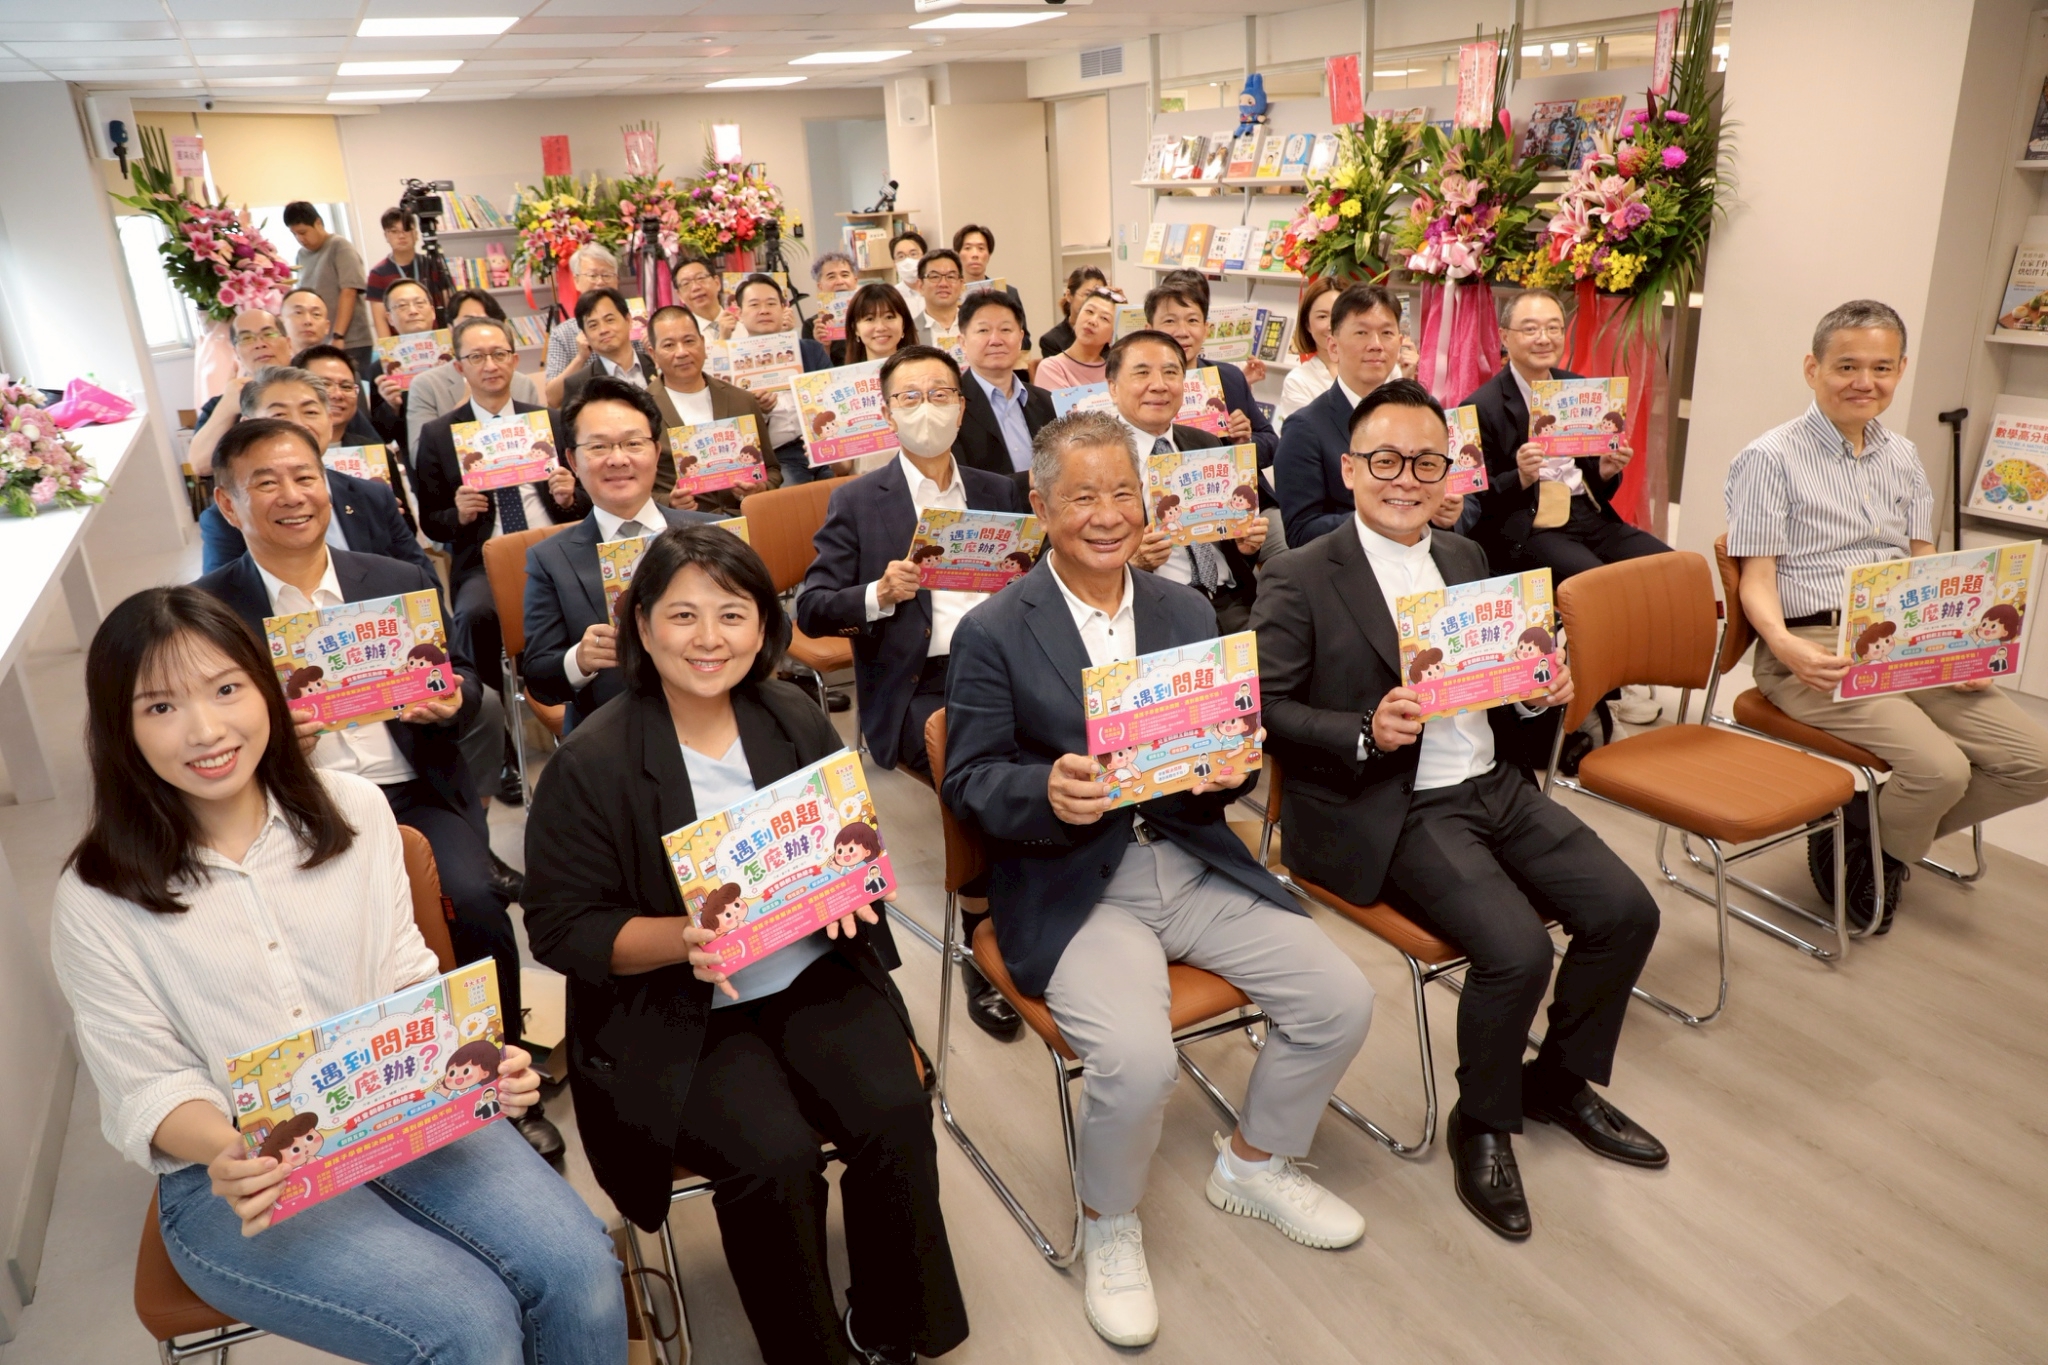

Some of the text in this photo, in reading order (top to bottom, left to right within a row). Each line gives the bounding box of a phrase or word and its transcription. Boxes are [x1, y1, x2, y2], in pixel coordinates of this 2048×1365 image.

[1557, 392, 1603, 409] 遇到問題
[1560, 405, 1602, 421] 怎麼辦?
[1179, 463, 1229, 487] 遇到問題
[1184, 479, 1231, 500] 怎麼辦?
[950, 527, 1012, 542] 遇到問題
[950, 541, 1008, 555] 怎麼辦?
[1899, 574, 1984, 610] 遇到問題
[1440, 599, 1513, 638] 遇到問題
[1903, 596, 1981, 629] 怎麼辦?
[317, 619, 399, 655] 遇到問題
[1448, 620, 1515, 655] 怎麼辦?
[328, 638, 402, 672] 怎麼辦?
[1133, 668, 1215, 709] 遇到問題
[729, 800, 821, 867] 遇到問題
[743, 825, 827, 885] 怎麼辦?
[310, 1015, 435, 1094] 遇到問題
[325, 1043, 440, 1115] 怎麼辦?
